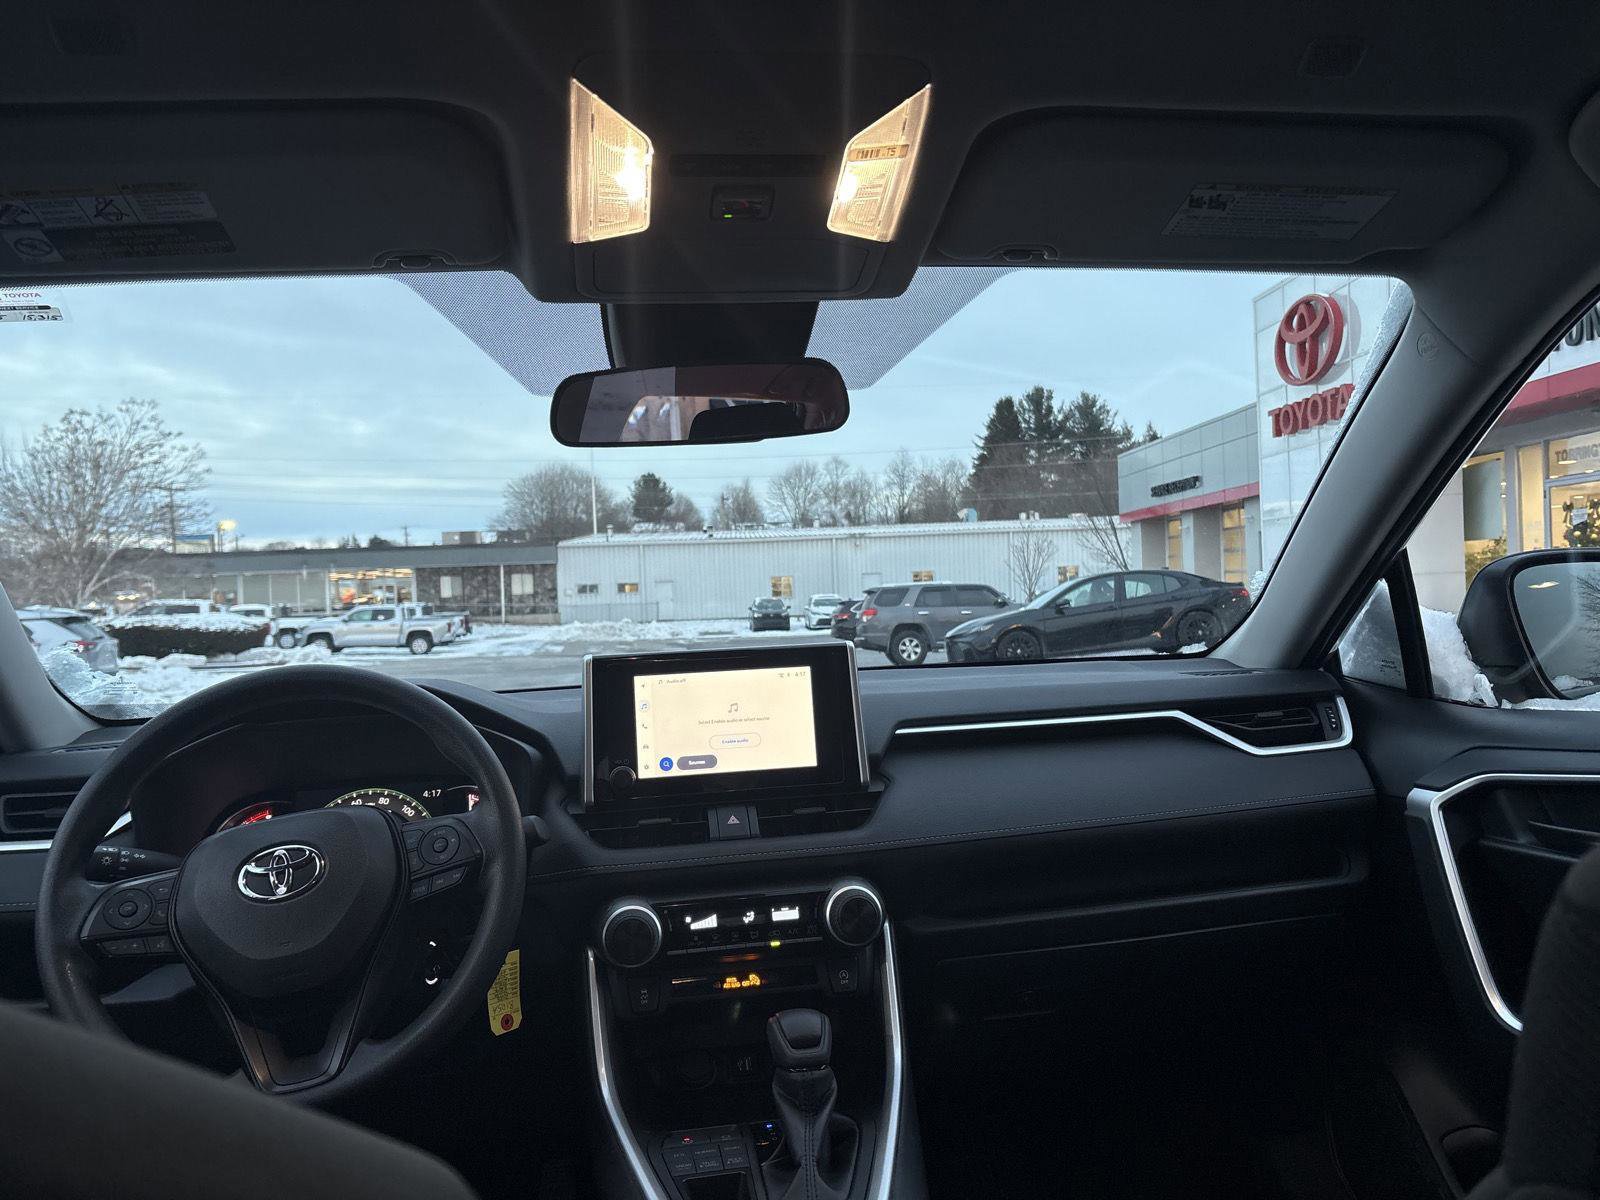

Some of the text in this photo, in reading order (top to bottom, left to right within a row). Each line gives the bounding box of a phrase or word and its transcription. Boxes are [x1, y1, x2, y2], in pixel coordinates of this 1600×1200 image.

[1268, 383, 1355, 438] TOYOTA
[422, 789, 442, 798] 4:17
[378, 797, 390, 805] 80
[401, 804, 415, 817] 100
